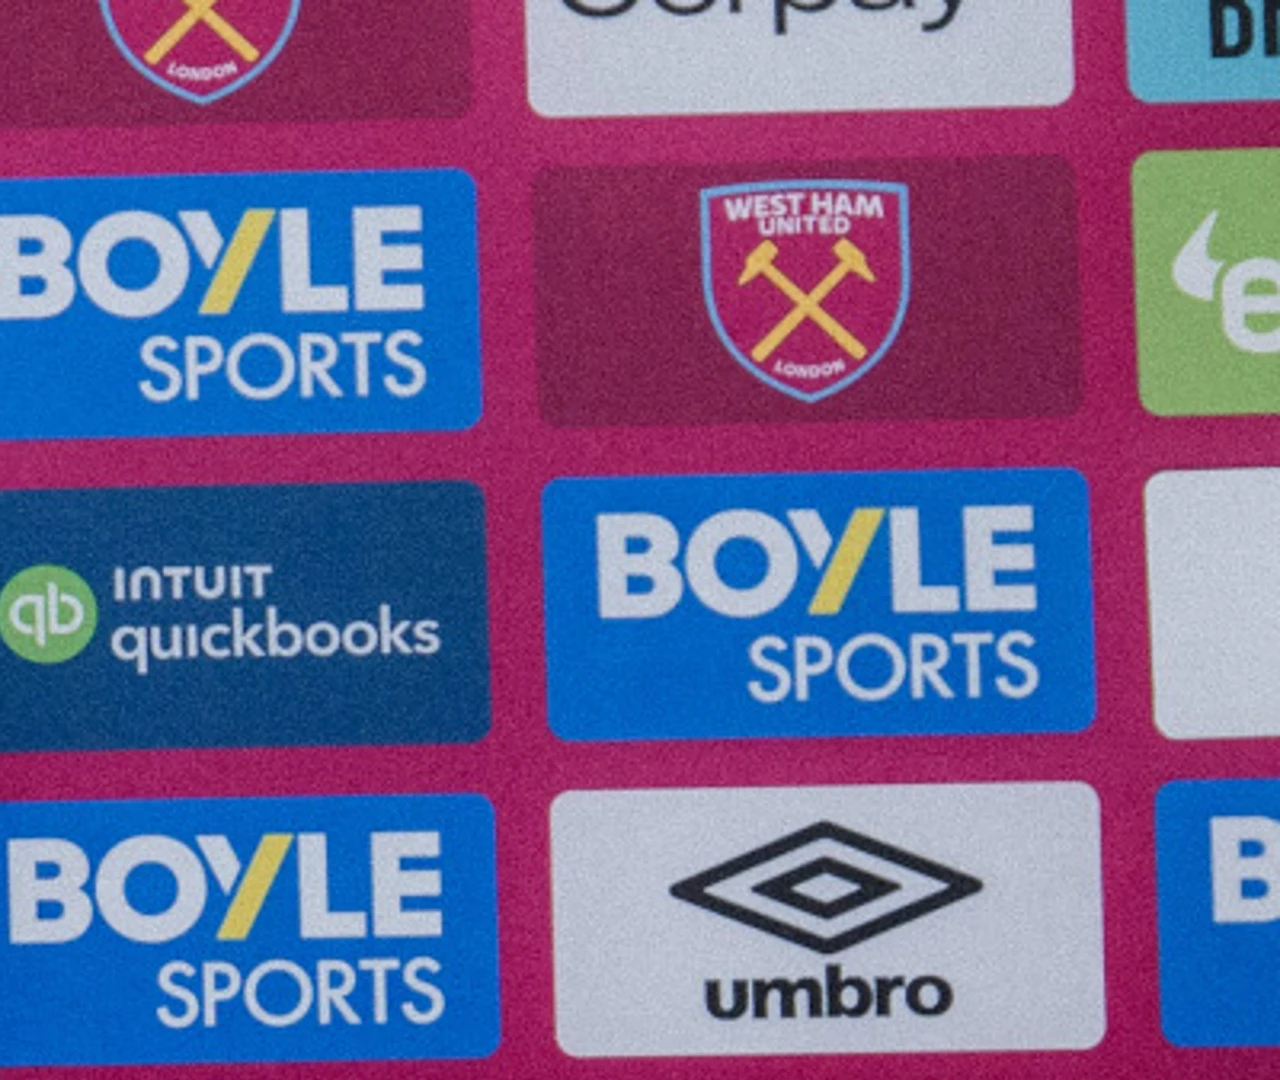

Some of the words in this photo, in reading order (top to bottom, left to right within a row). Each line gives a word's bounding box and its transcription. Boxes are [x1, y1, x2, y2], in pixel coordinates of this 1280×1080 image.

[168, 58, 238, 82] LONDON
[724, 193, 806, 222] WEST
[810, 192, 884, 219] HAM
[757, 214, 852, 236] UNITED
[139, 330, 427, 402] SPORTS
[773, 357, 847, 379] LONDON
[112, 565, 273, 600] INTUIT
[596, 506, 1037, 619] BOYLE
[7, 582, 85, 645] qb
[110, 610, 440, 675] quickbooks
[747, 631, 1040, 703] SPORTS
[6, 831, 441, 945] BOYLE
[156, 957, 446, 1030] SPORTS
[703, 963, 954, 1020] umbro
